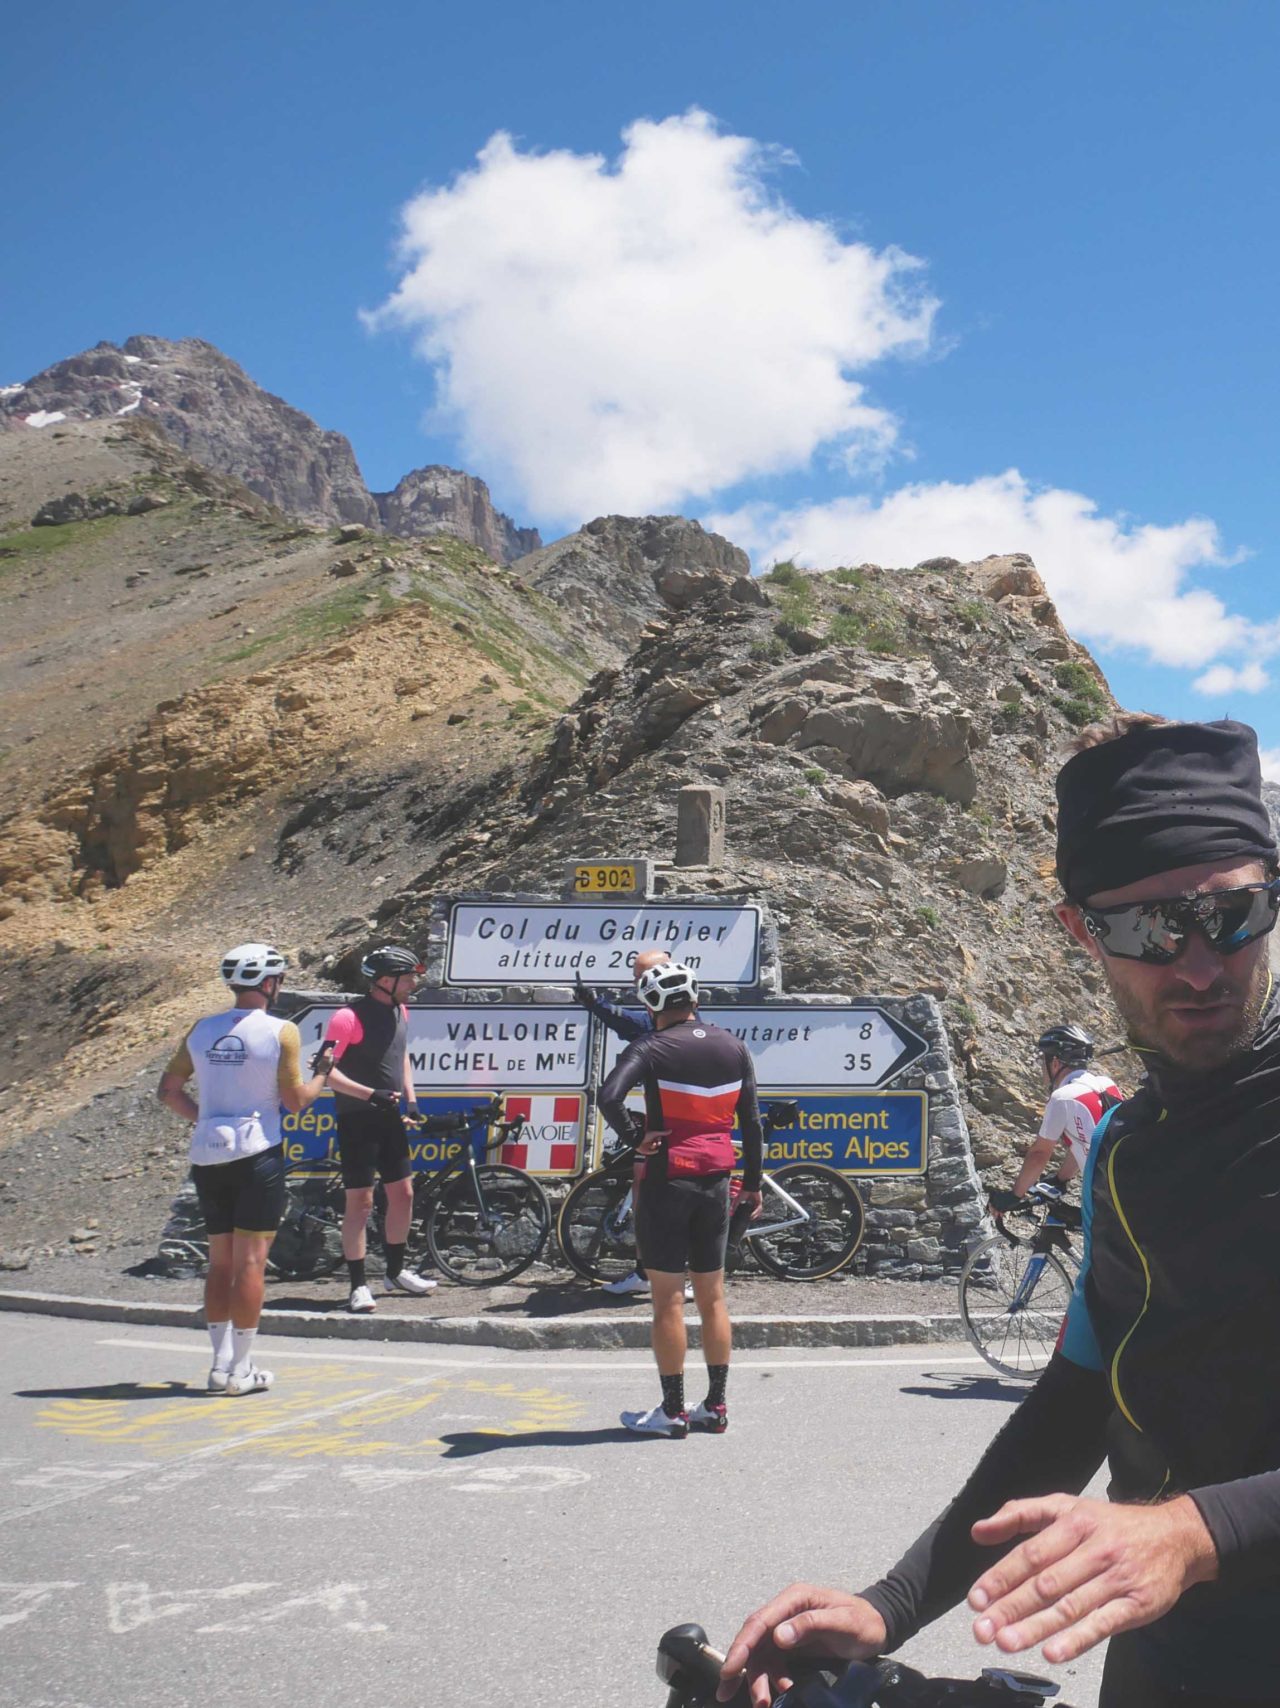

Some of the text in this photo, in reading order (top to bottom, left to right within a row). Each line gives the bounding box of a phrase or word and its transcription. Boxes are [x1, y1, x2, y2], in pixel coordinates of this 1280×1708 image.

[597, 869, 631, 888] 902
[478, 917, 727, 942] Col du Galibier
[498, 950, 597, 969] altitude
[684, 955, 702, 969] m
[447, 1022, 578, 1042] VALLOIRE
[859, 1021, 873, 1041] 8
[409, 1052, 499, 1071] MICHEL
[507, 1059, 526, 1071] DE
[843, 1053, 872, 1072] 35
[517, 1125, 571, 1141] AVOIE
[408, 1137, 463, 1161] voie
[844, 1135, 910, 1164] Alpes
